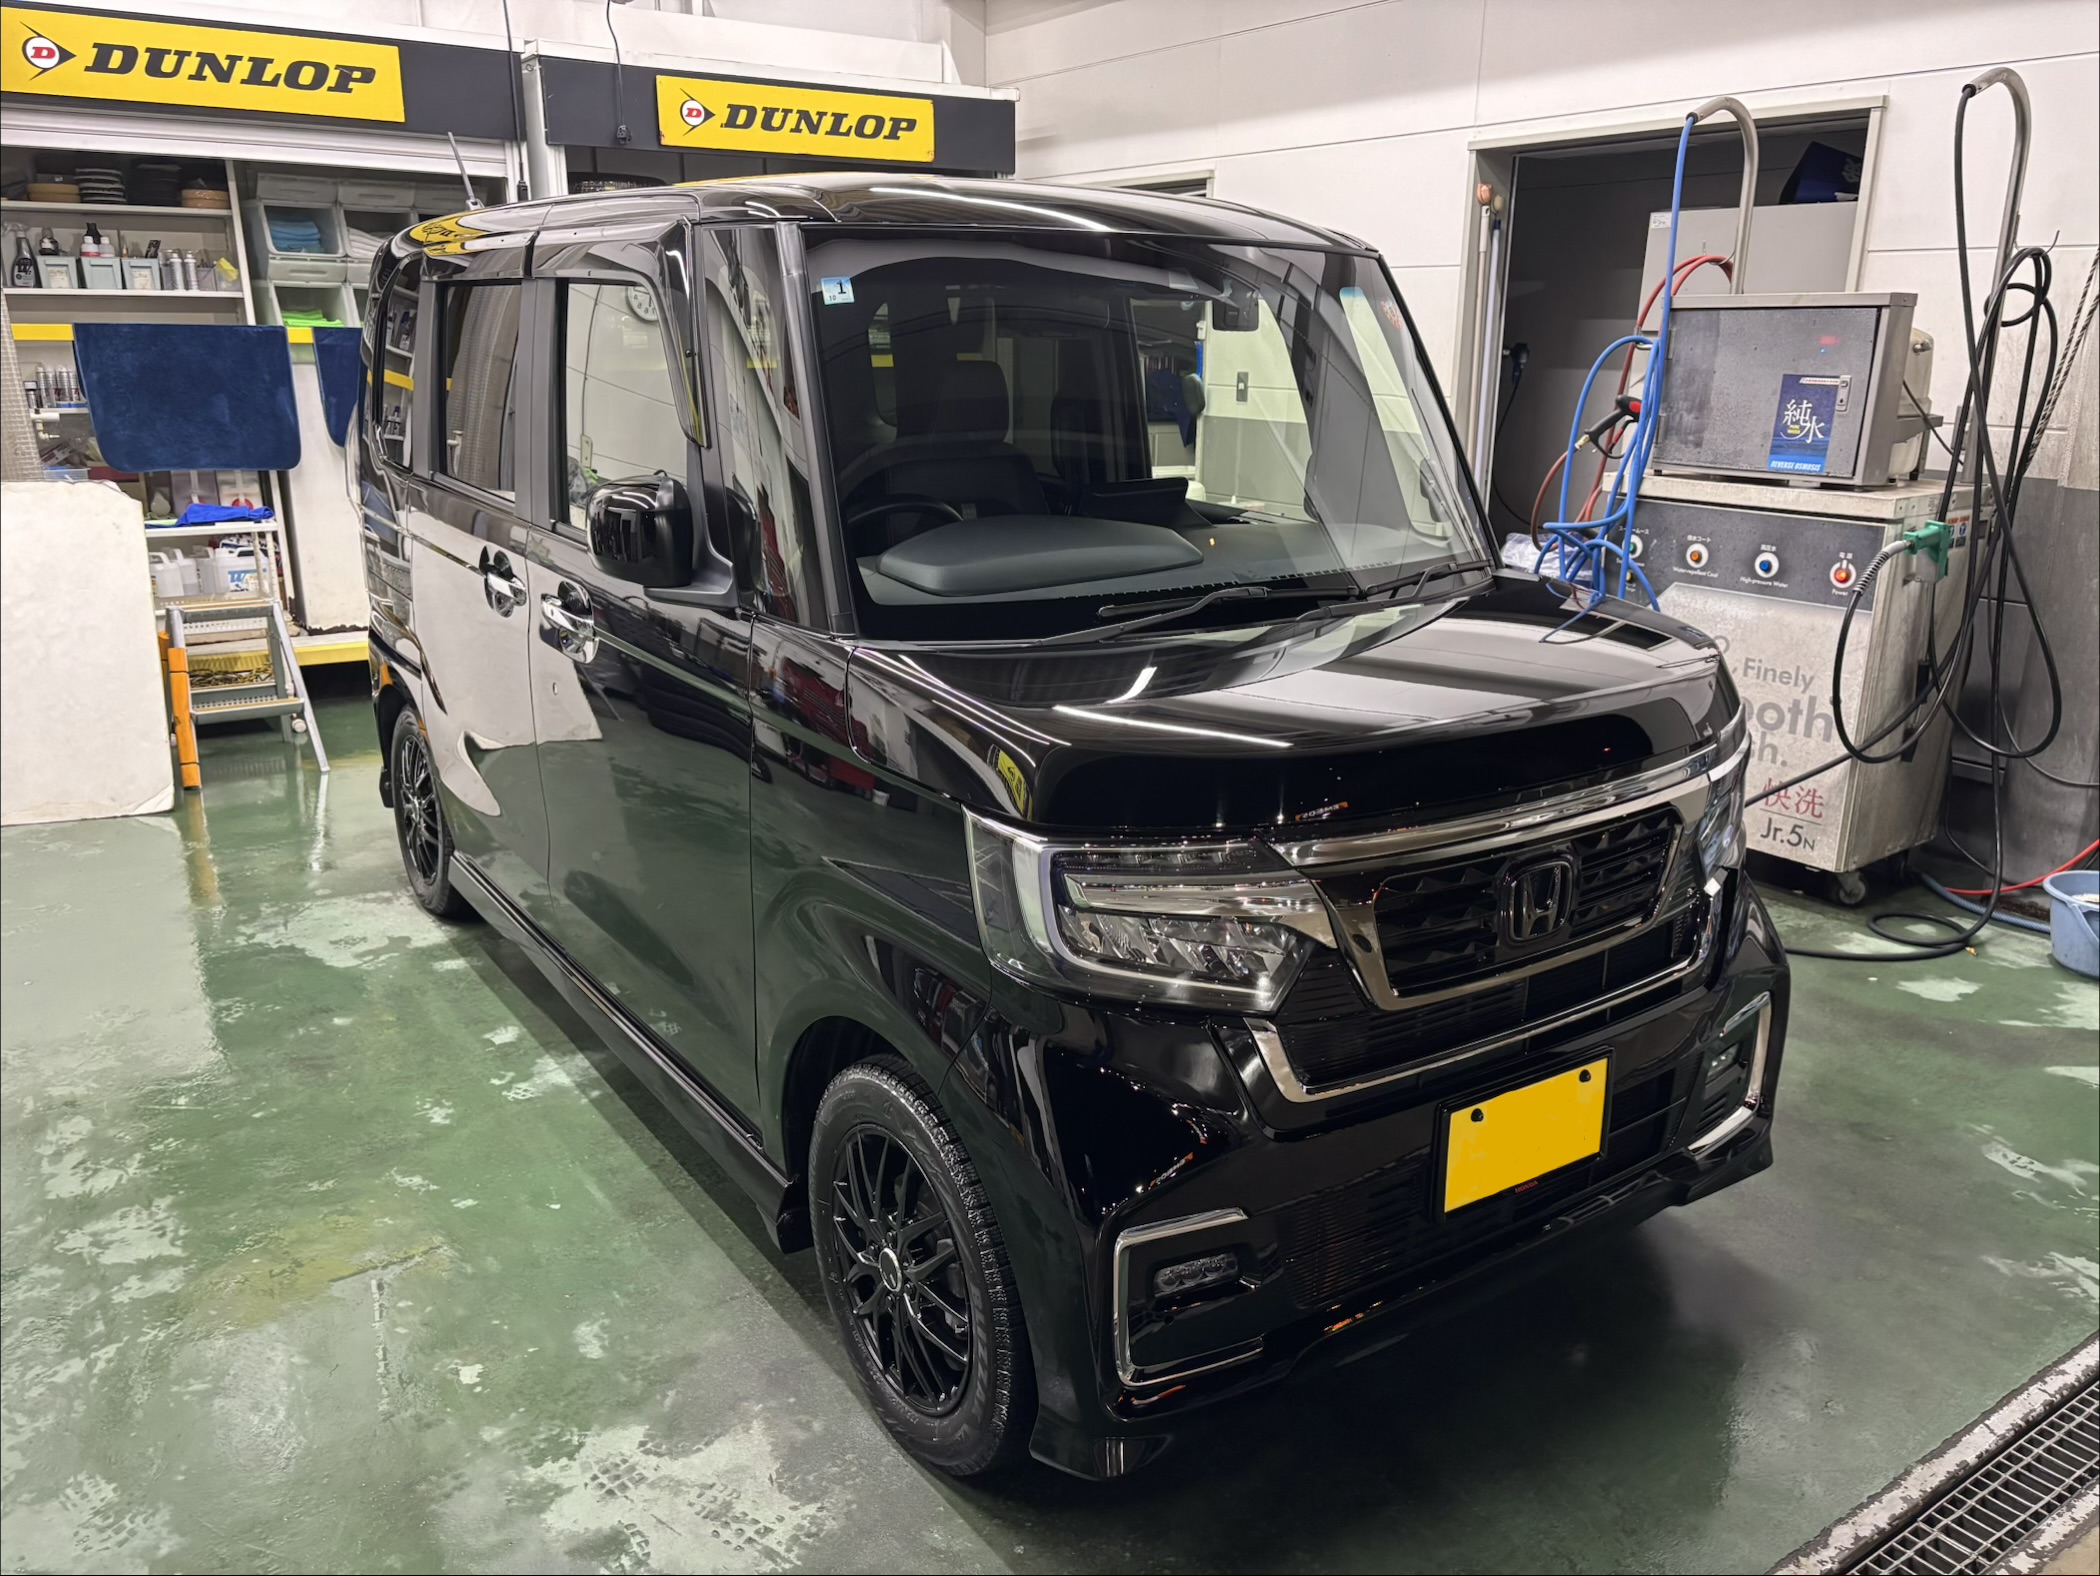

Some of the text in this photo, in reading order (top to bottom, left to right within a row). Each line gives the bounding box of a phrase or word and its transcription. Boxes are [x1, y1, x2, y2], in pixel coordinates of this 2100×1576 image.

[31, 42, 376, 94] D DUNLOP
[684, 103, 917, 141] D DUNLOP
[836, 280, 847, 295] 1
[1781, 399, 1825, 444] 純水
[1831, 588, 1849, 596] Power
[1743, 657, 1815, 694] Finely
[1762, 777, 1825, 819] 快洗
[1760, 817, 1816, 851] Jr.5N
[970, 1282, 988, 1424] BLIZZAK
